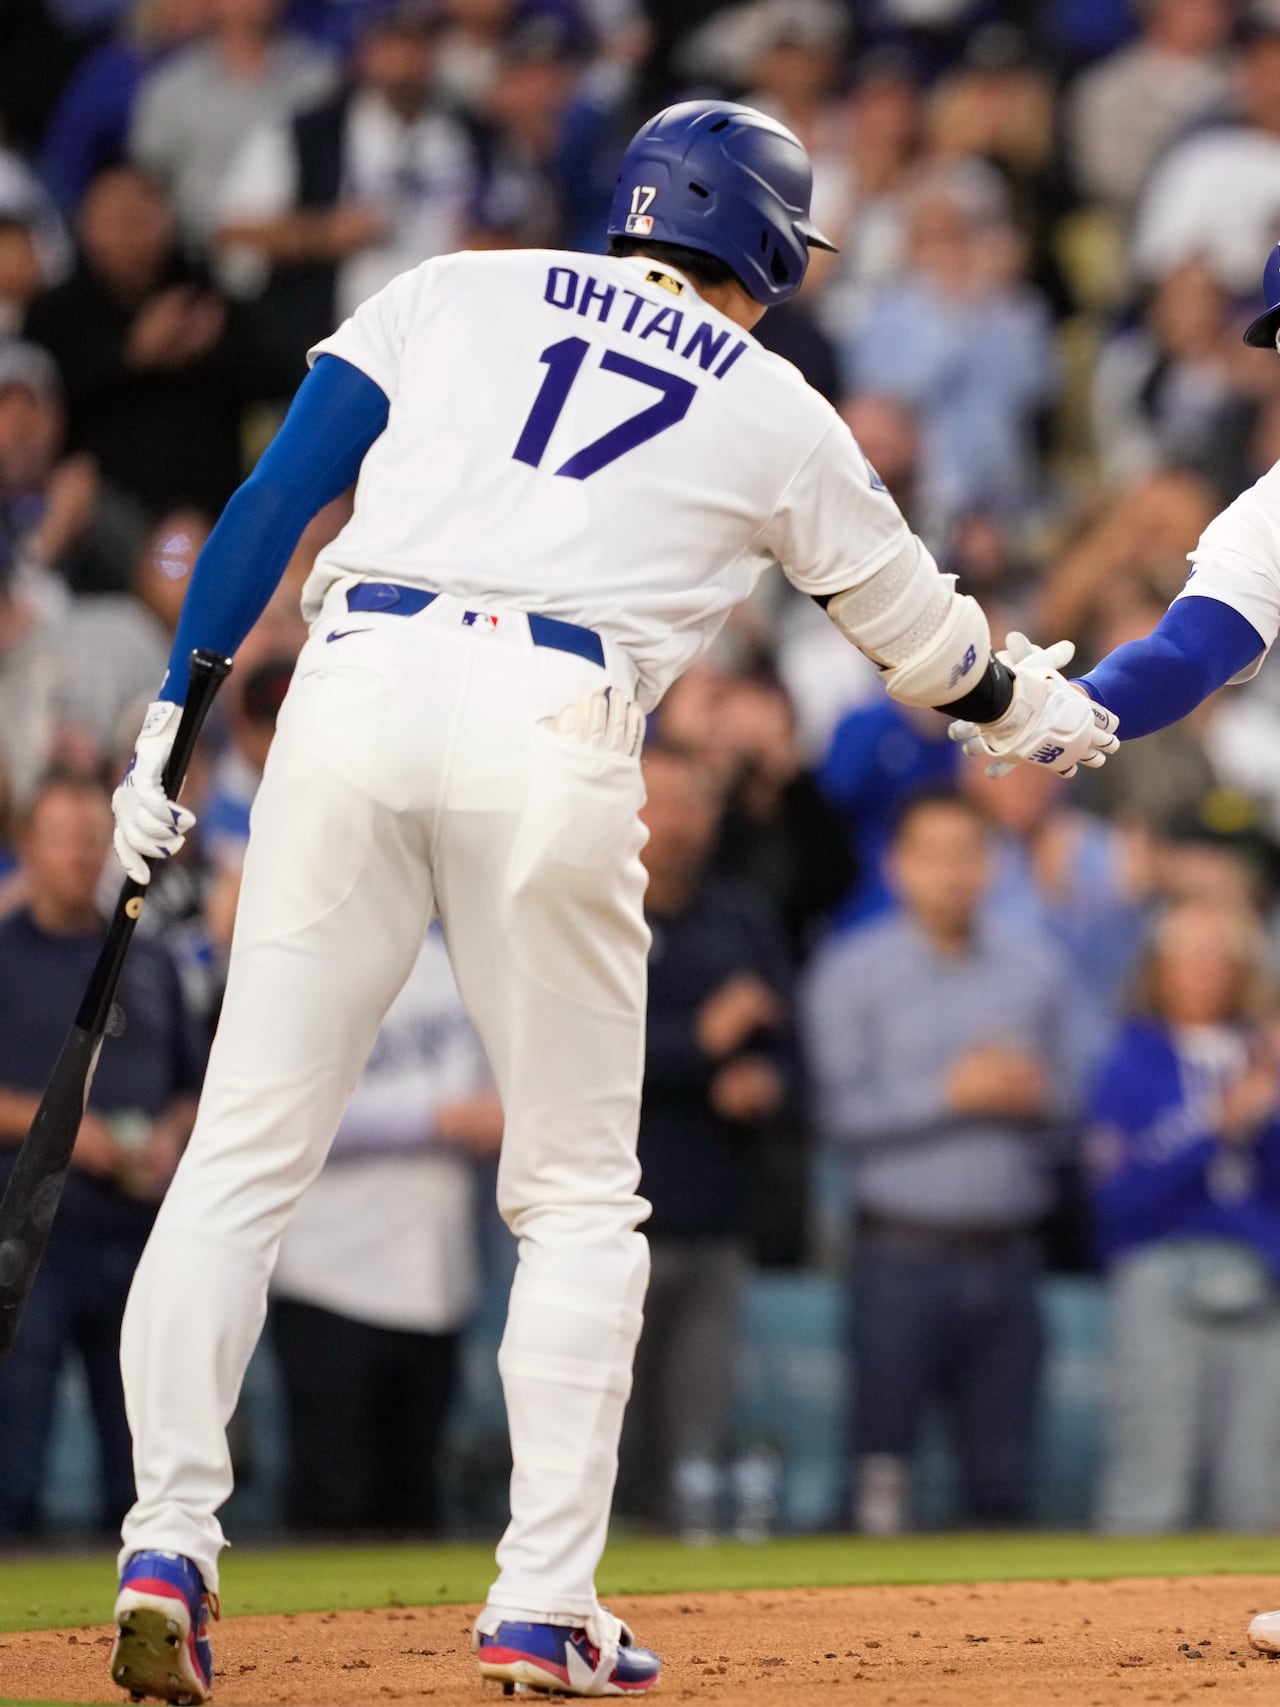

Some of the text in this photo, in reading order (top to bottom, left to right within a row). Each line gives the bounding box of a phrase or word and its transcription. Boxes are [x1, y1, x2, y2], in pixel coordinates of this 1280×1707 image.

[630, 185, 657, 215] 17
[544, 266, 748, 380] OHTANI
[512, 336, 698, 480] 17
